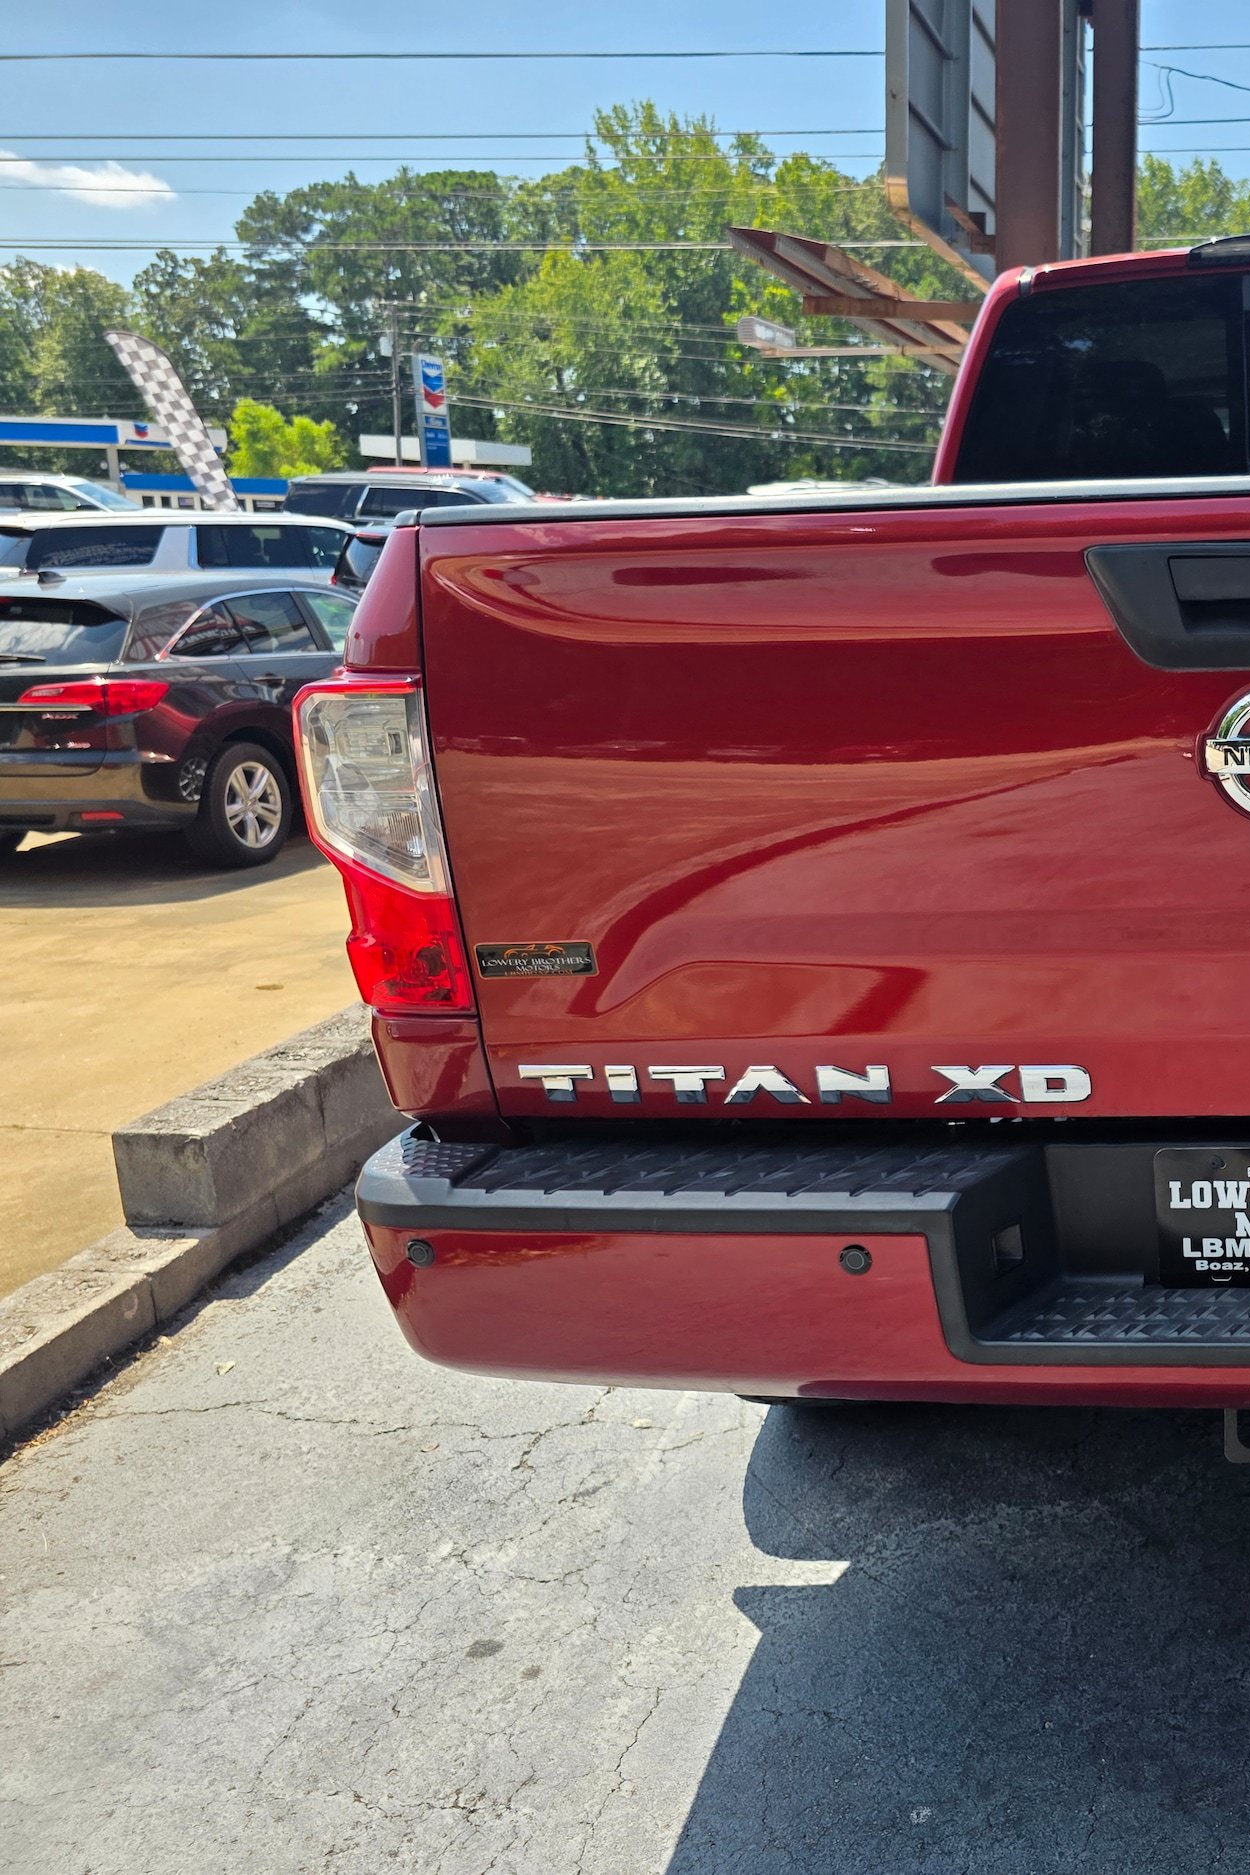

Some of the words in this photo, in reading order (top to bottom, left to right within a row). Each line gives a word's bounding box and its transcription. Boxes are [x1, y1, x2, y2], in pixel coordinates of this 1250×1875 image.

[482, 958, 529, 967] LOWERY
[531, 956, 592, 966] BROTHERS
[515, 964, 561, 972] MOTORS
[518, 1064, 892, 1104] TITAN
[931, 1064, 1093, 1103] XD
[1195, 1260, 1250, 1272] Boaz,
